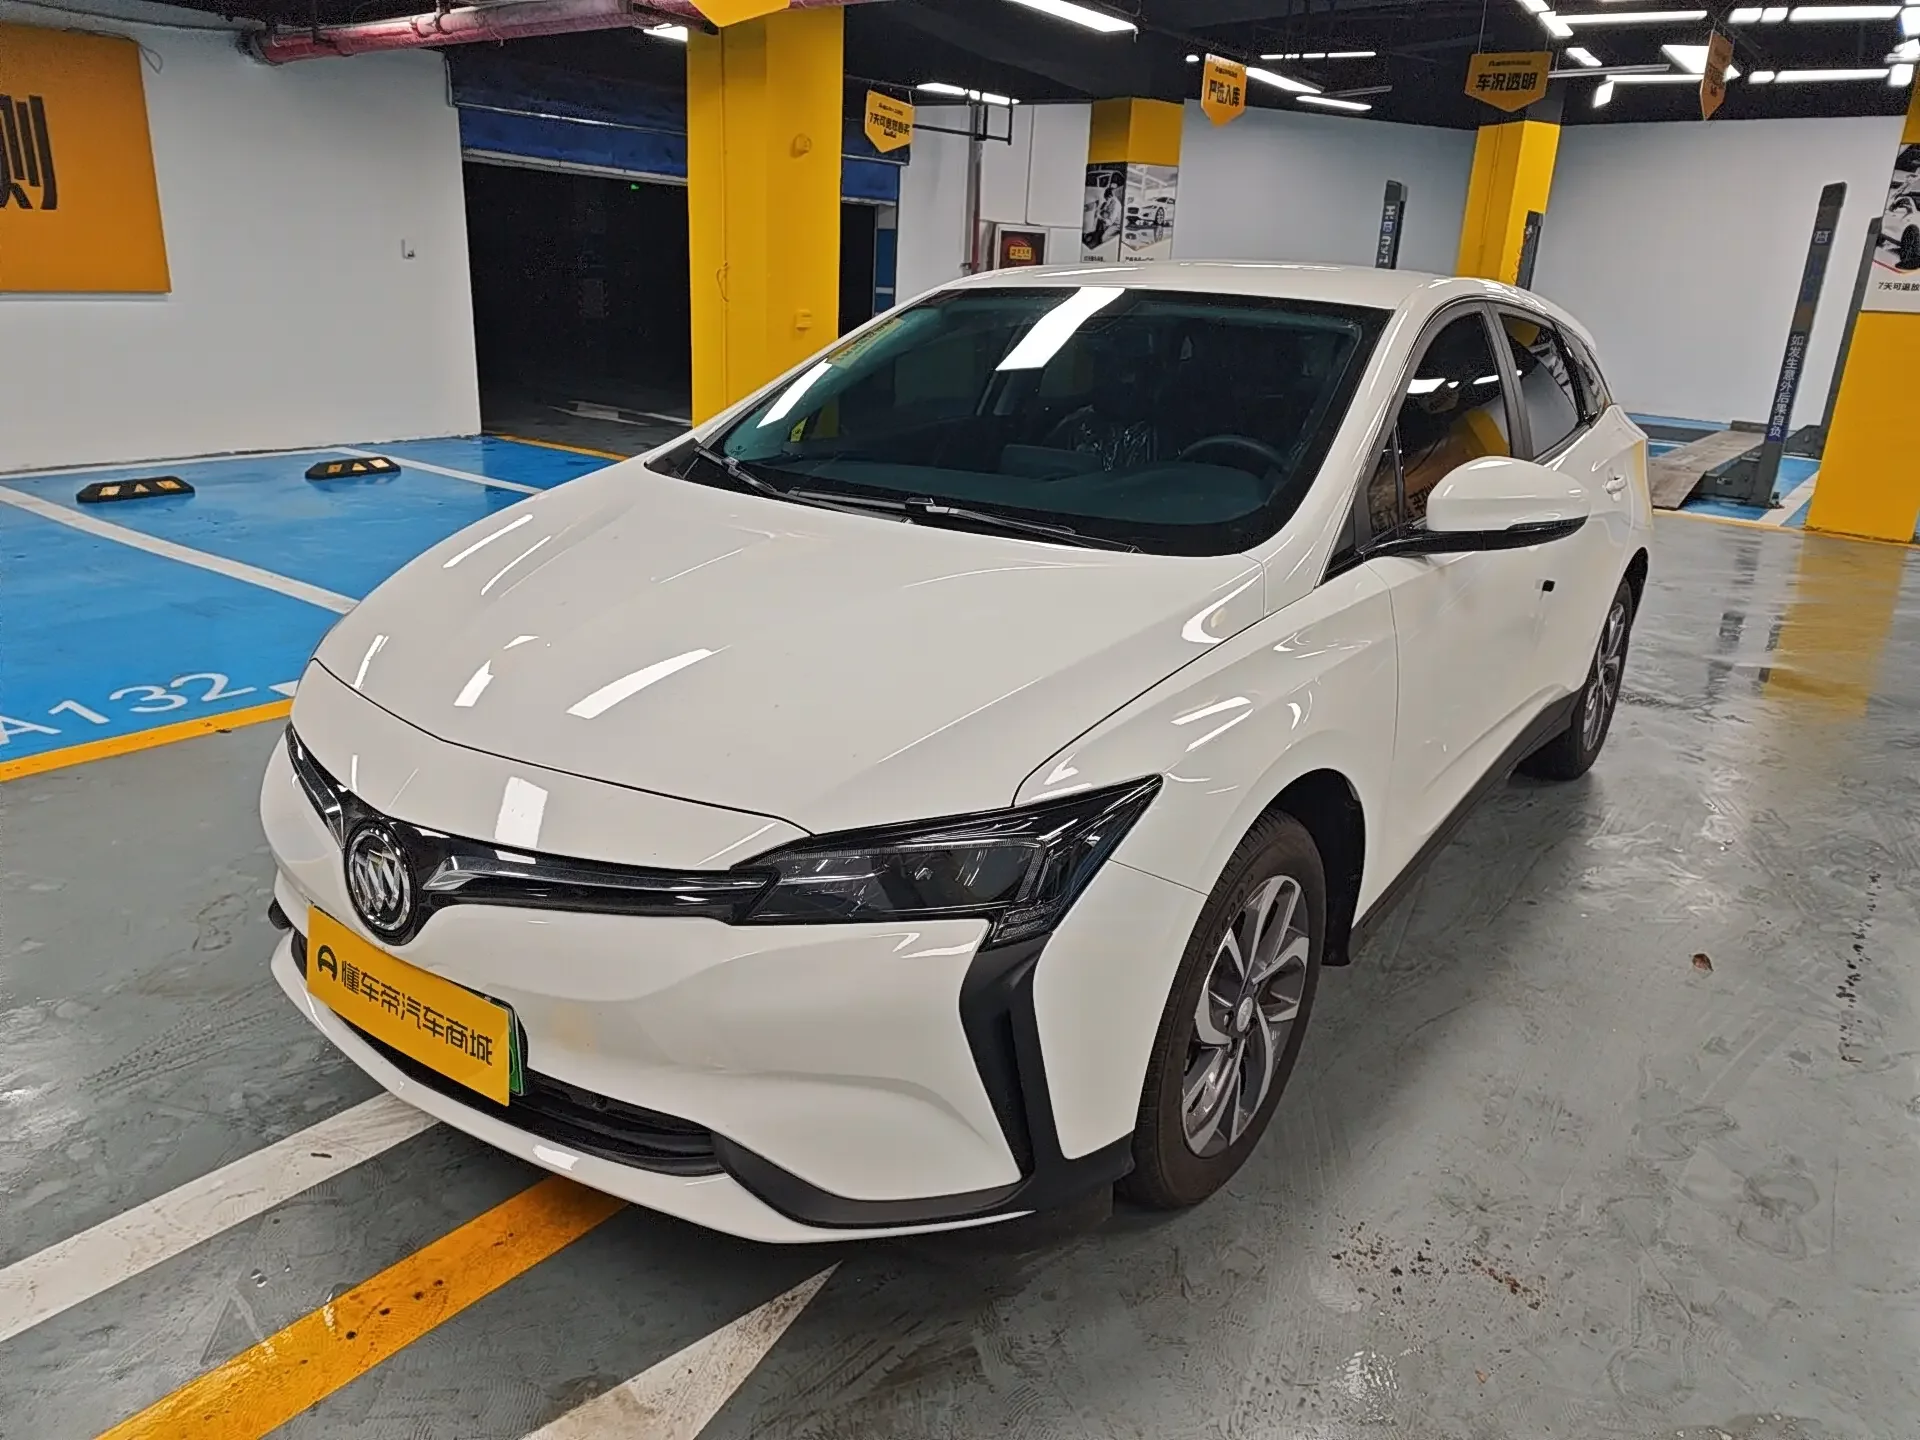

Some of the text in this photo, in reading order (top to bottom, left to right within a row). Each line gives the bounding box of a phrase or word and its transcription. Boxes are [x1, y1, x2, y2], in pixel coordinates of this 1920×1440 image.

[1208, 79, 1240, 107] 严选入库
[1476, 72, 1538, 91] 车况透明
[1769, 334, 1804, 437] 如发生意外后果自负
[0, 672, 257, 745] A132
[341, 960, 493, 1066] 懂车帝汽车商城
